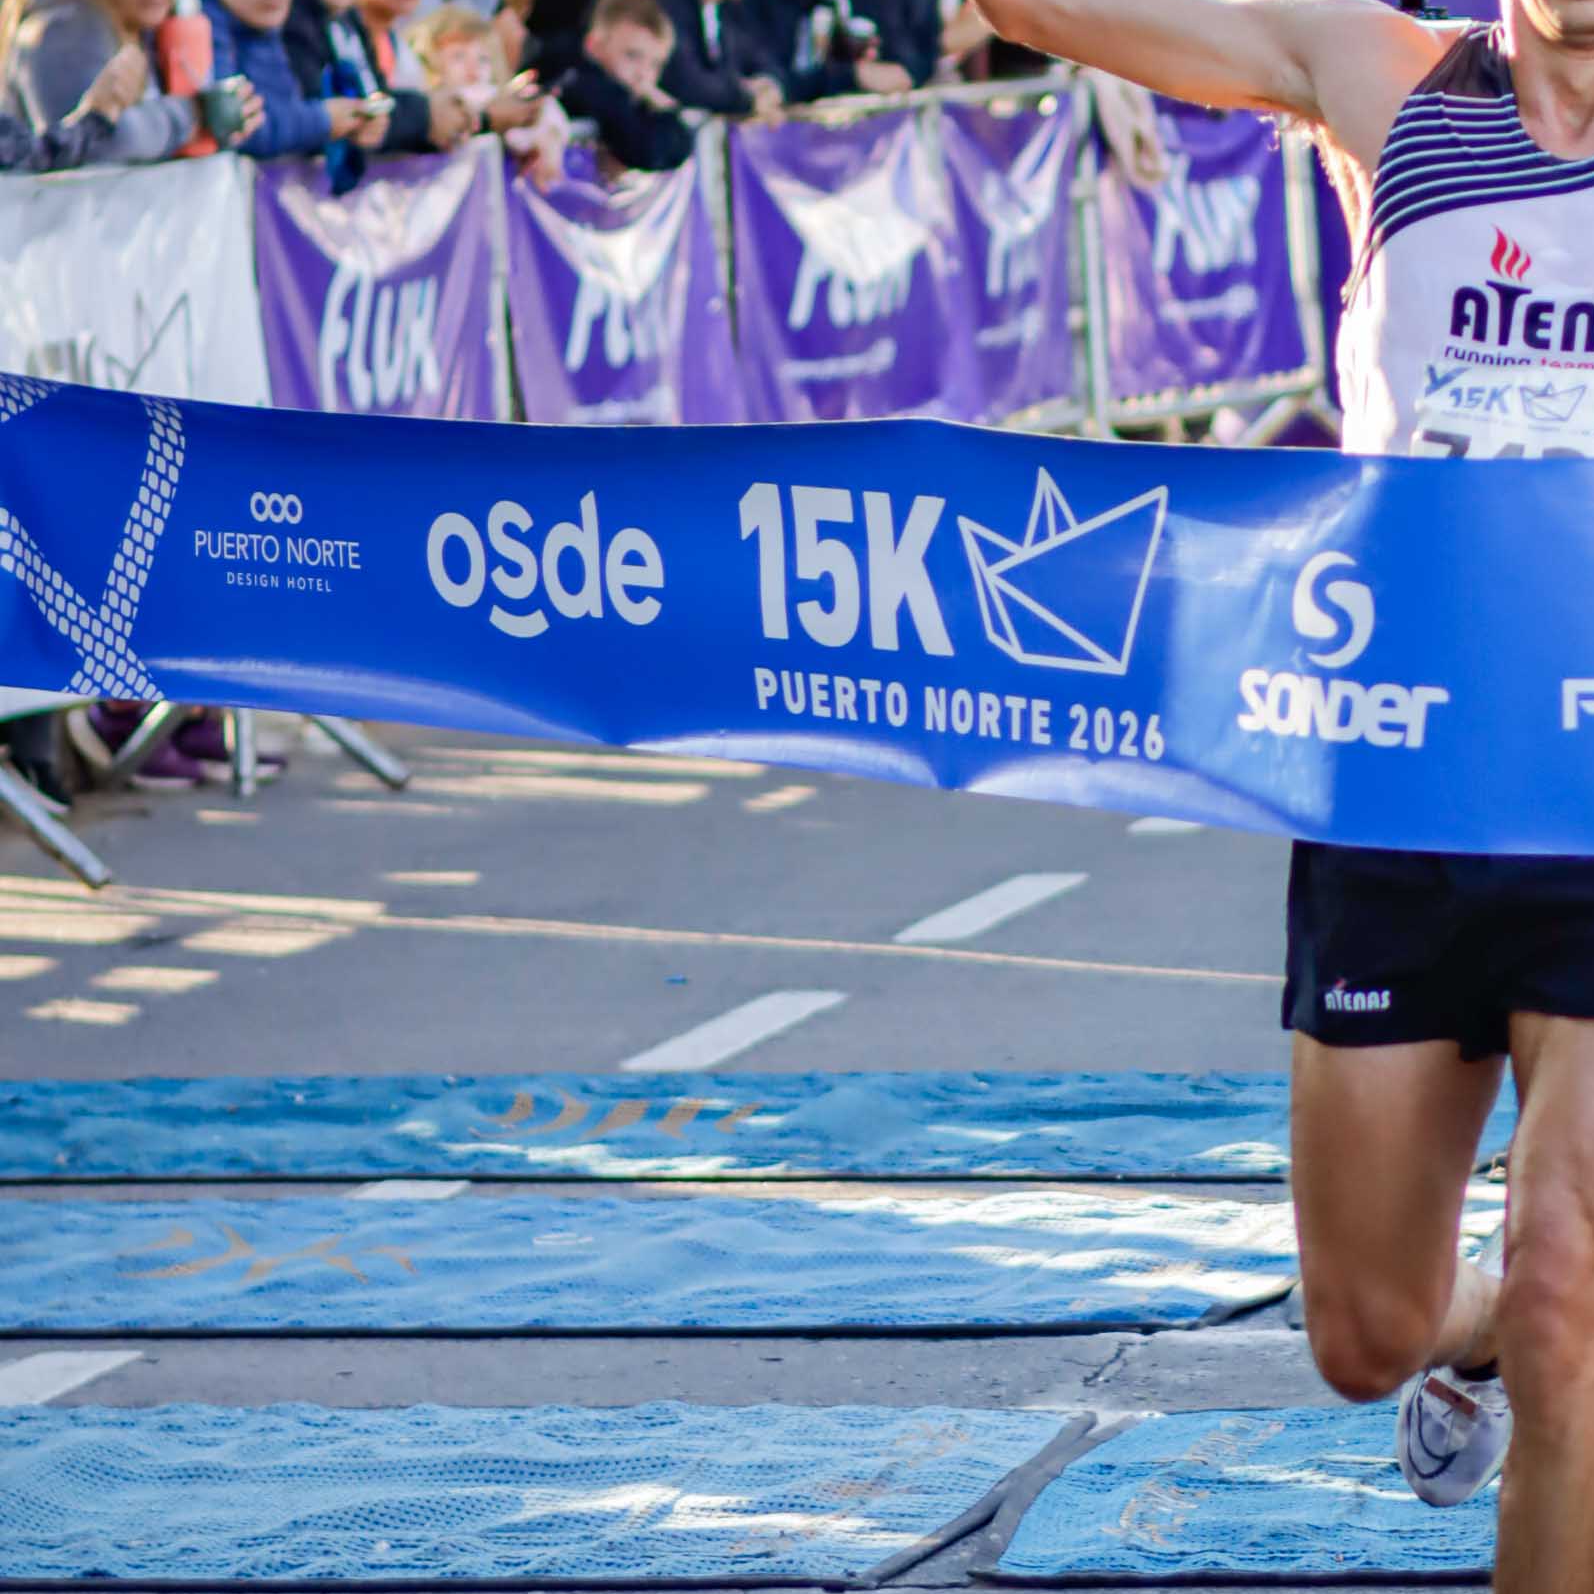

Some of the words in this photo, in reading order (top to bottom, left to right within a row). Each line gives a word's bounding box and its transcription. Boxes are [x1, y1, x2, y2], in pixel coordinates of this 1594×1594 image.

[194, 529, 281, 563] PUERTO
[286, 536, 361, 570] NORTE
[226, 571, 280, 589] DESIGN
[286, 576, 333, 593] HOTEL
[738, 482, 954, 657] 15K
[753, 667, 909, 728] PUERTO
[923, 686, 1052, 747] NORTE
[1068, 703, 1166, 761] 2026
